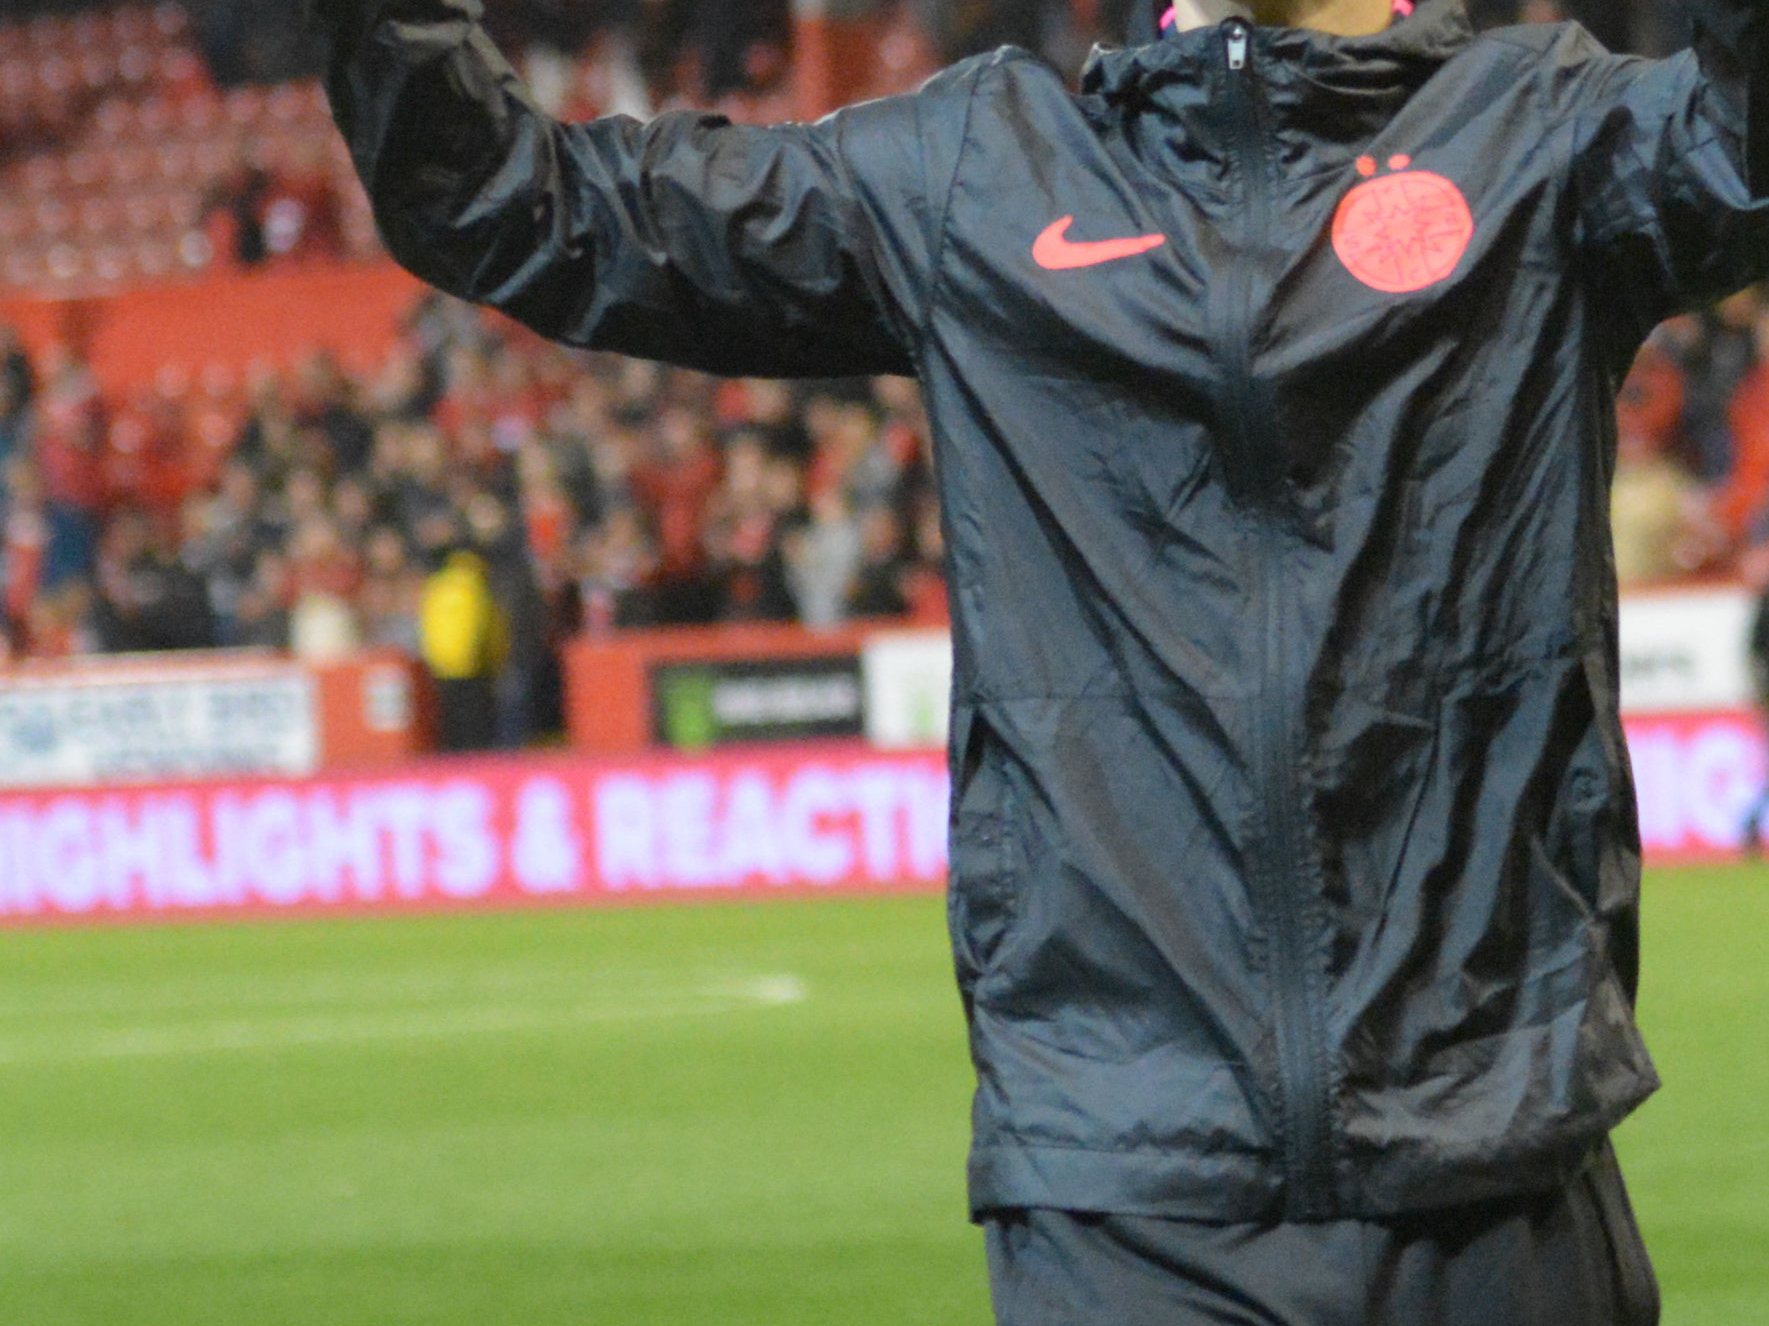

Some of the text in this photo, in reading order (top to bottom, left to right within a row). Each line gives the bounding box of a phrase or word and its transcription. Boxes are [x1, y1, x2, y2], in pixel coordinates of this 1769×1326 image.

[0, 761, 949, 915] IGHLIGHTS & REACTI
